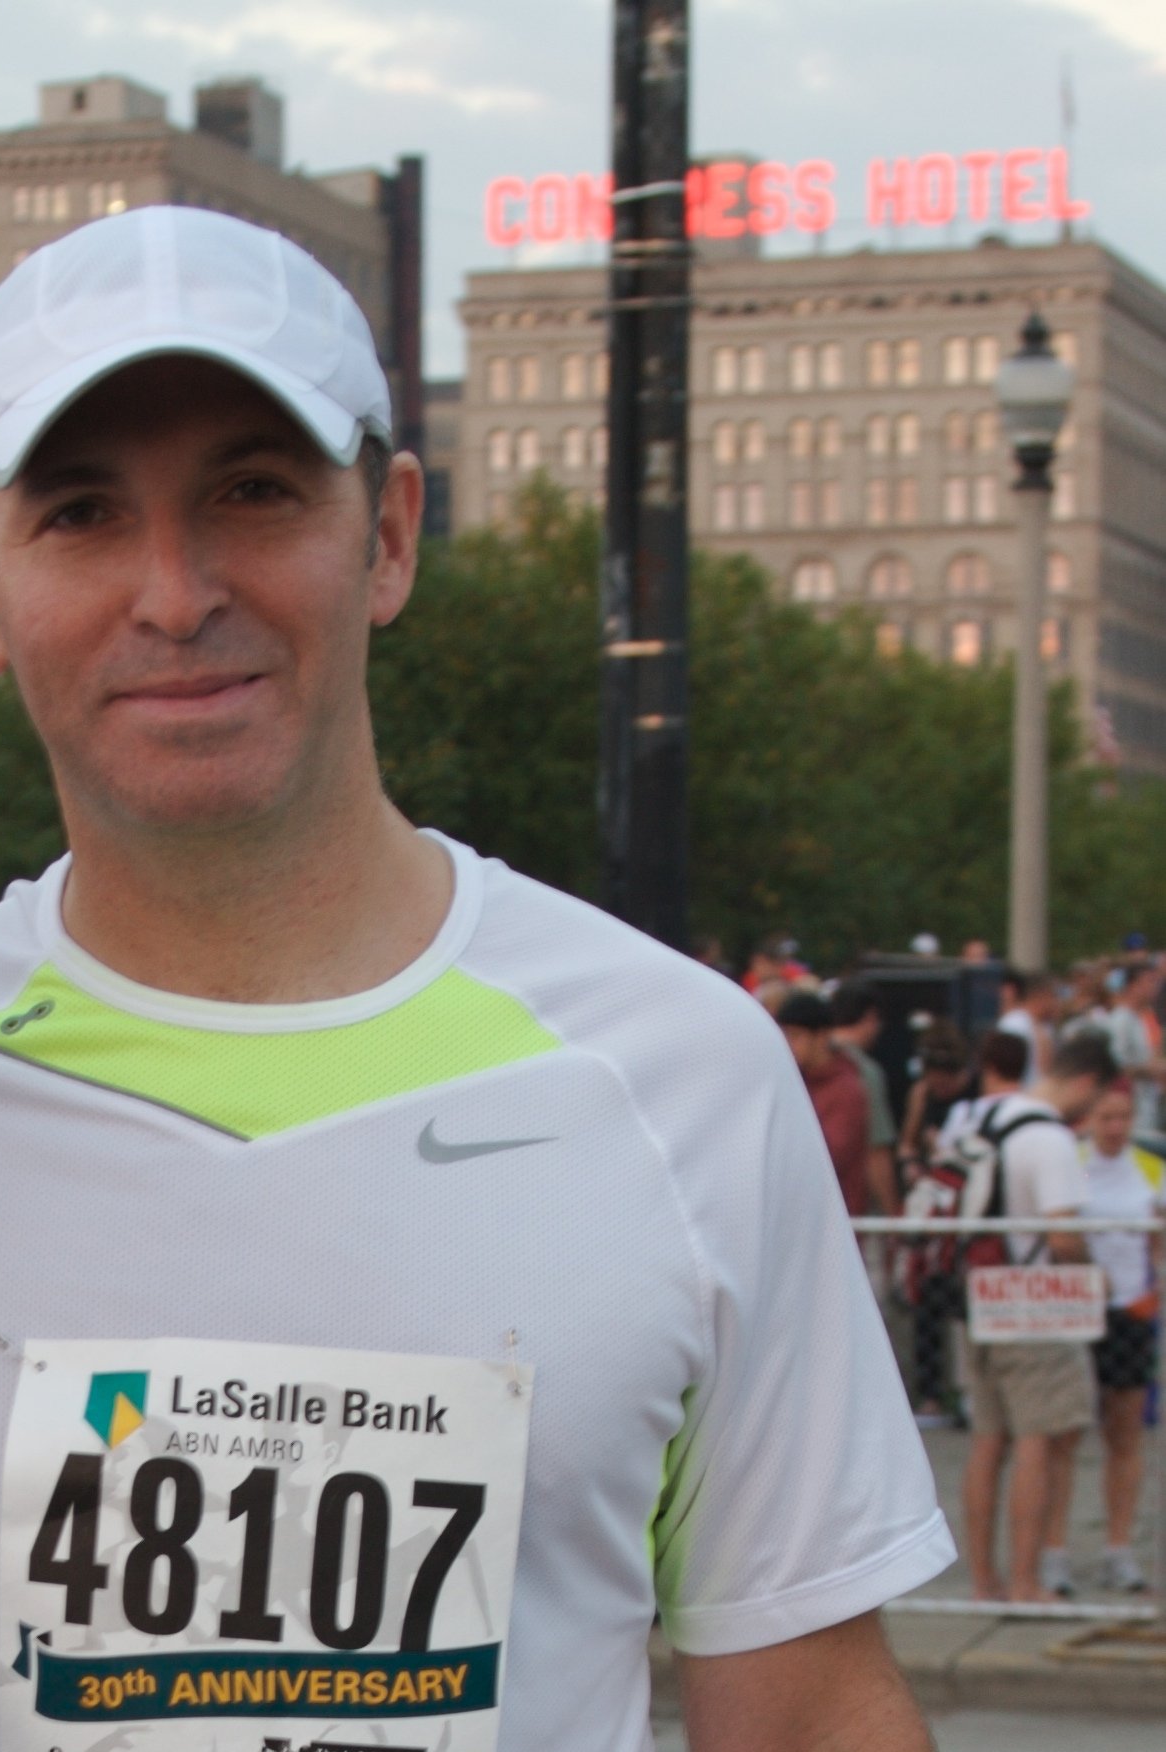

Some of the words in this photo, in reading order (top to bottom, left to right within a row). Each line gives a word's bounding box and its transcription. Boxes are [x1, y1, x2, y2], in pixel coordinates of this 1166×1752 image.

[484, 159, 836, 246] CONESS
[867, 147, 1093, 228] HOTEL
[171, 1374, 327, 1426] LaSalle
[341, 1387, 450, 1436] Bank
[166, 1430, 220, 1455] ABN
[229, 1434, 304, 1462] AMRO
[28, 1451, 488, 1653] 48107
[78, 1668, 157, 1709] 30th
[168, 1664, 470, 1708] ANNIVERSARY
